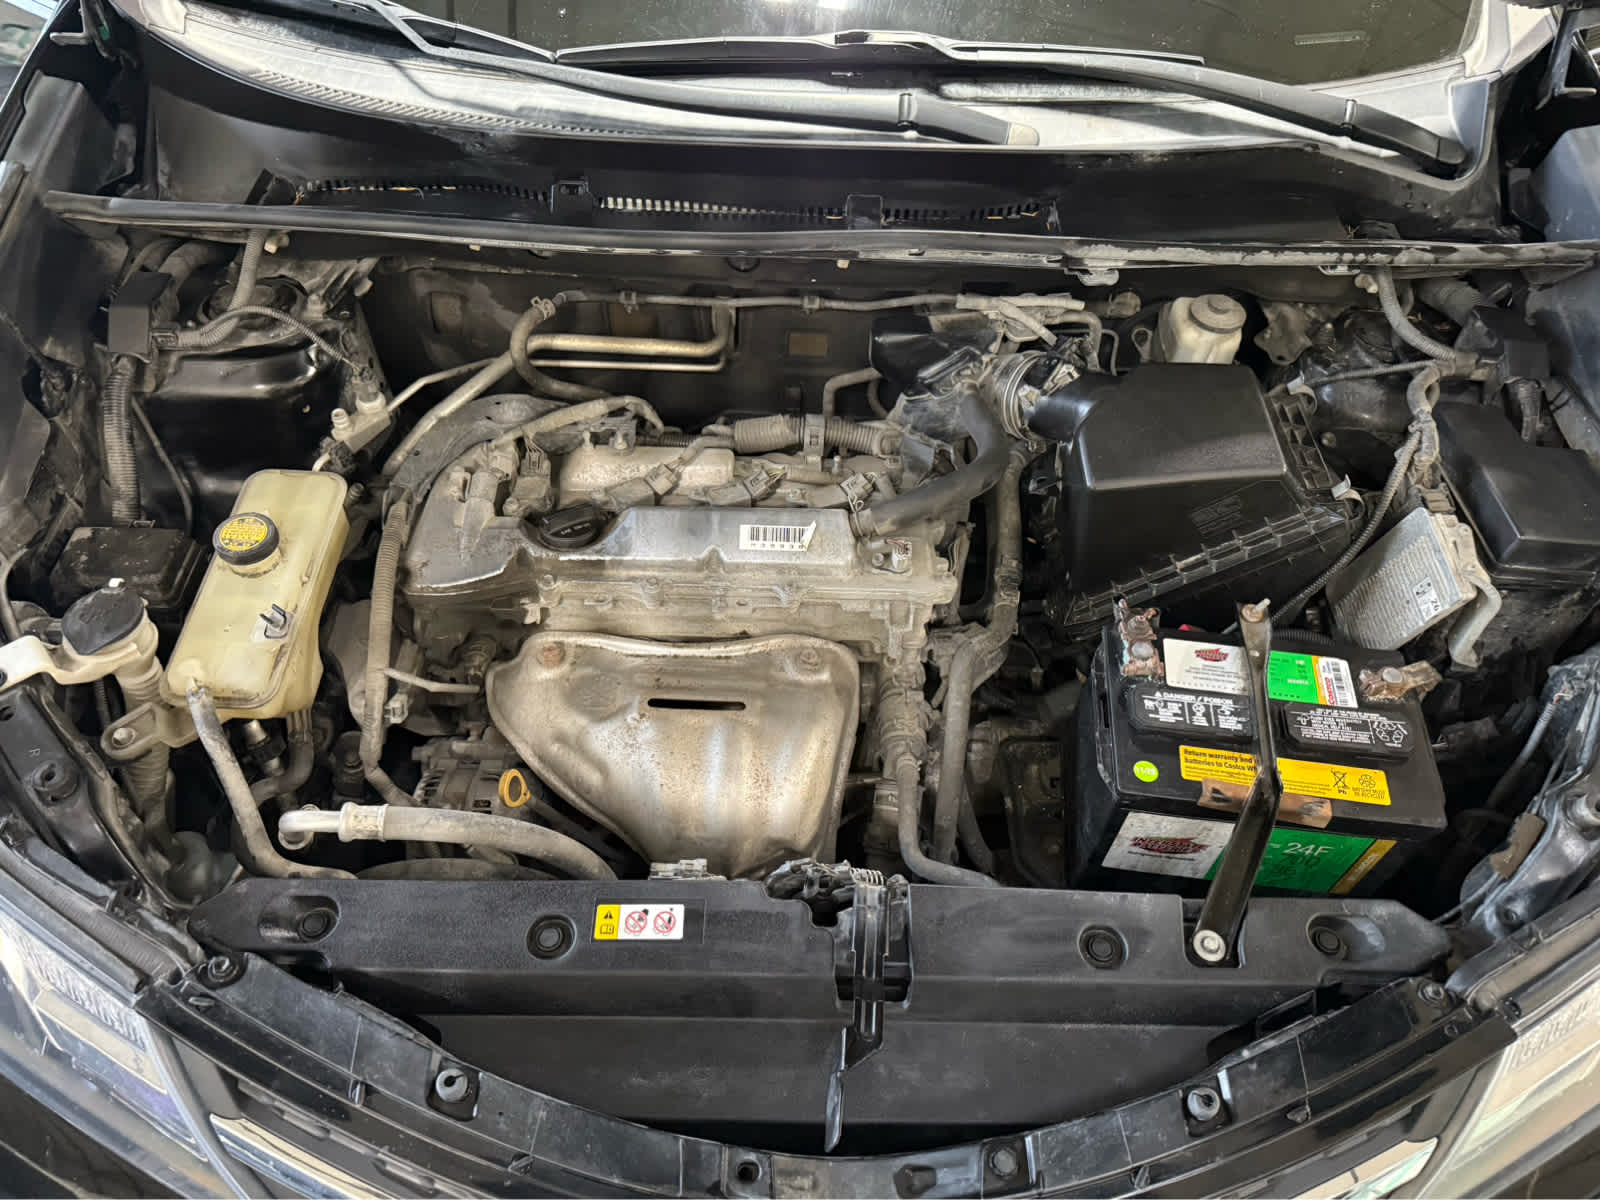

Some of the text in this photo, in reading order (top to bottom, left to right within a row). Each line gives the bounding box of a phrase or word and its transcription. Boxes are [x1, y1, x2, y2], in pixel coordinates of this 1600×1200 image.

[1163, 692, 1196, 702] DANGER
[1203, 696, 1233, 705] POISON
[1208, 752, 1239, 762] warranty
[1283, 842, 1335, 856] 24F
